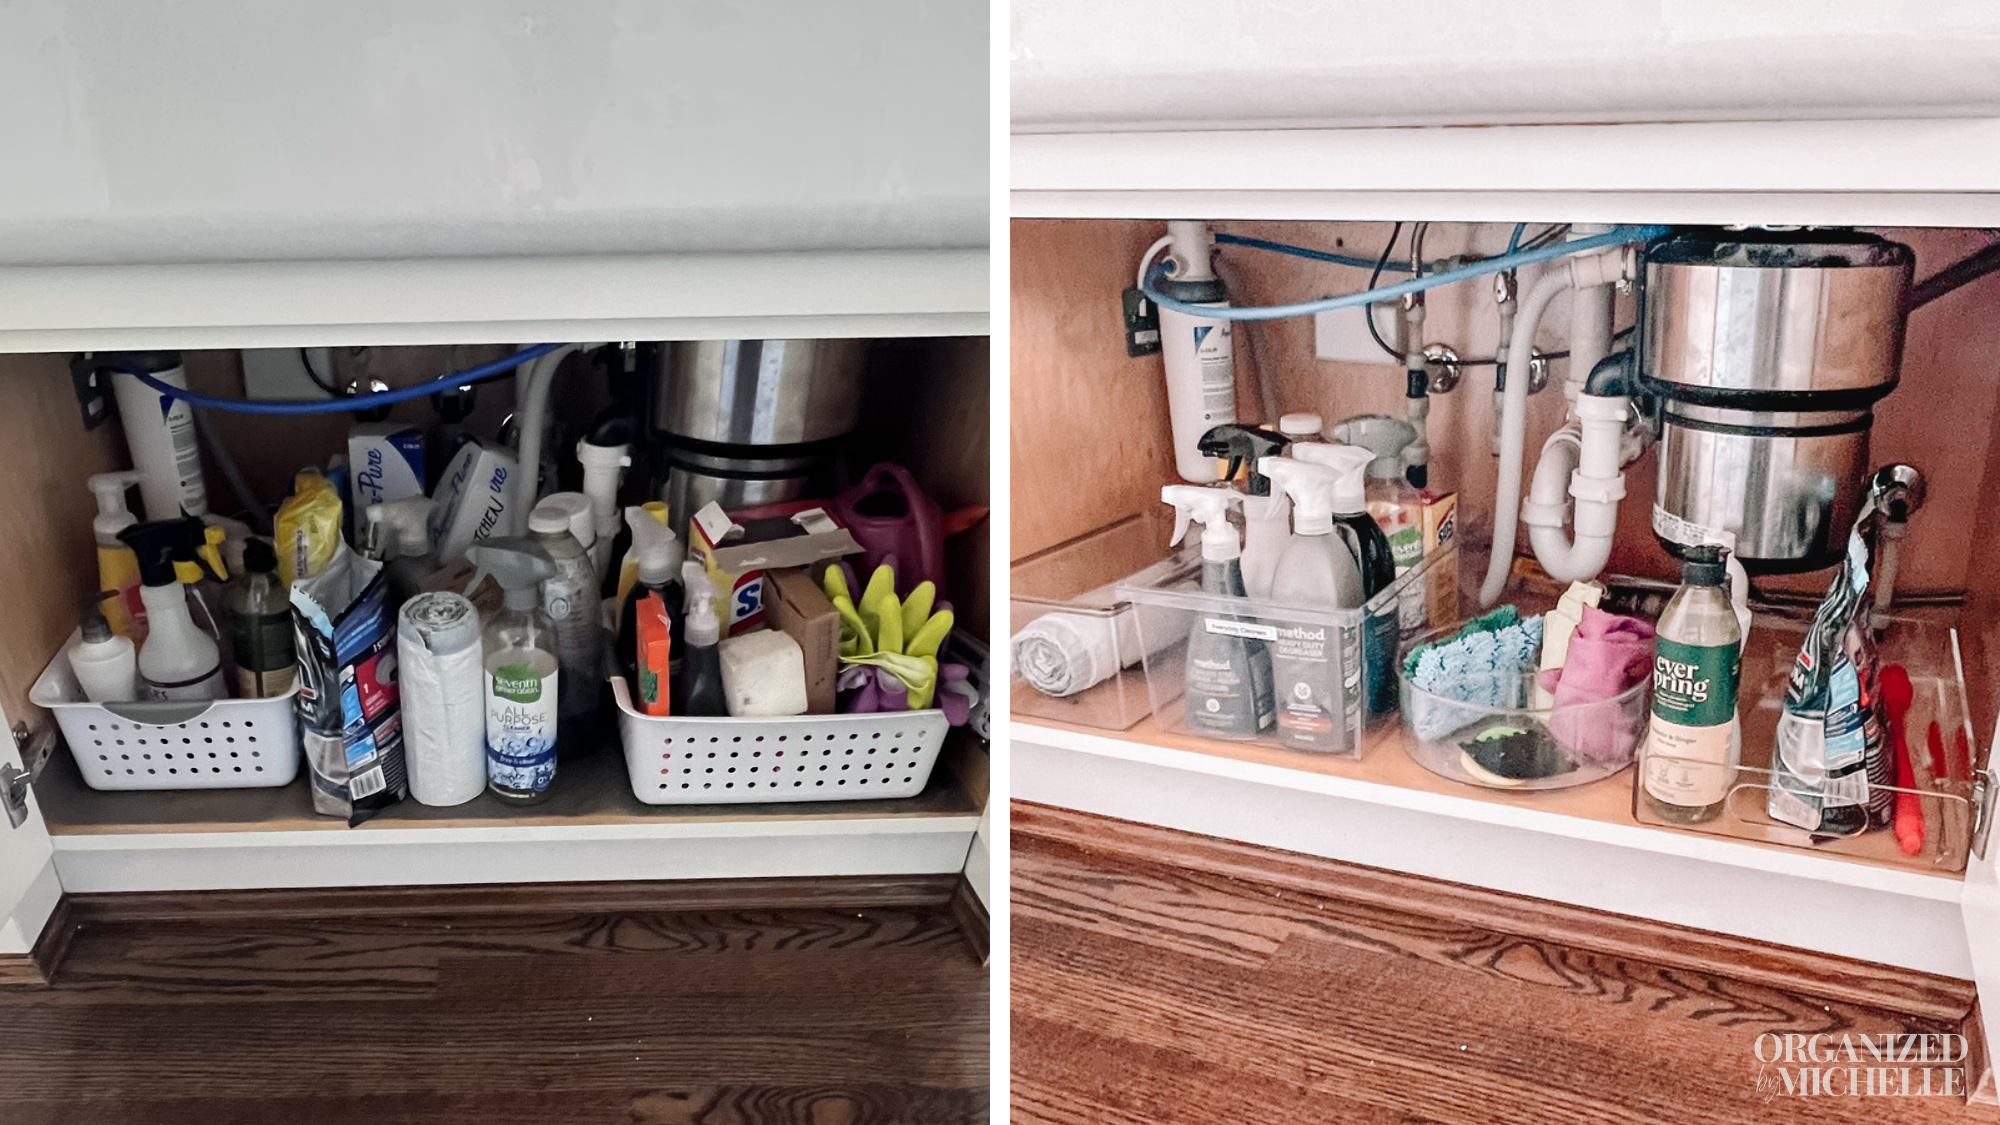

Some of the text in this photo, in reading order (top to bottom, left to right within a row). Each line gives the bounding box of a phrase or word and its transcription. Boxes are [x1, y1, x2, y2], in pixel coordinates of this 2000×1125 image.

[474, 495, 505, 541] TCHEN
[1657, 656, 1699, 679] ever
[495, 676, 538, 688] seventh
[1653, 668, 1710, 703] pring
[490, 709, 547, 725] PURPOSE
[504, 706, 529, 717] ALL
